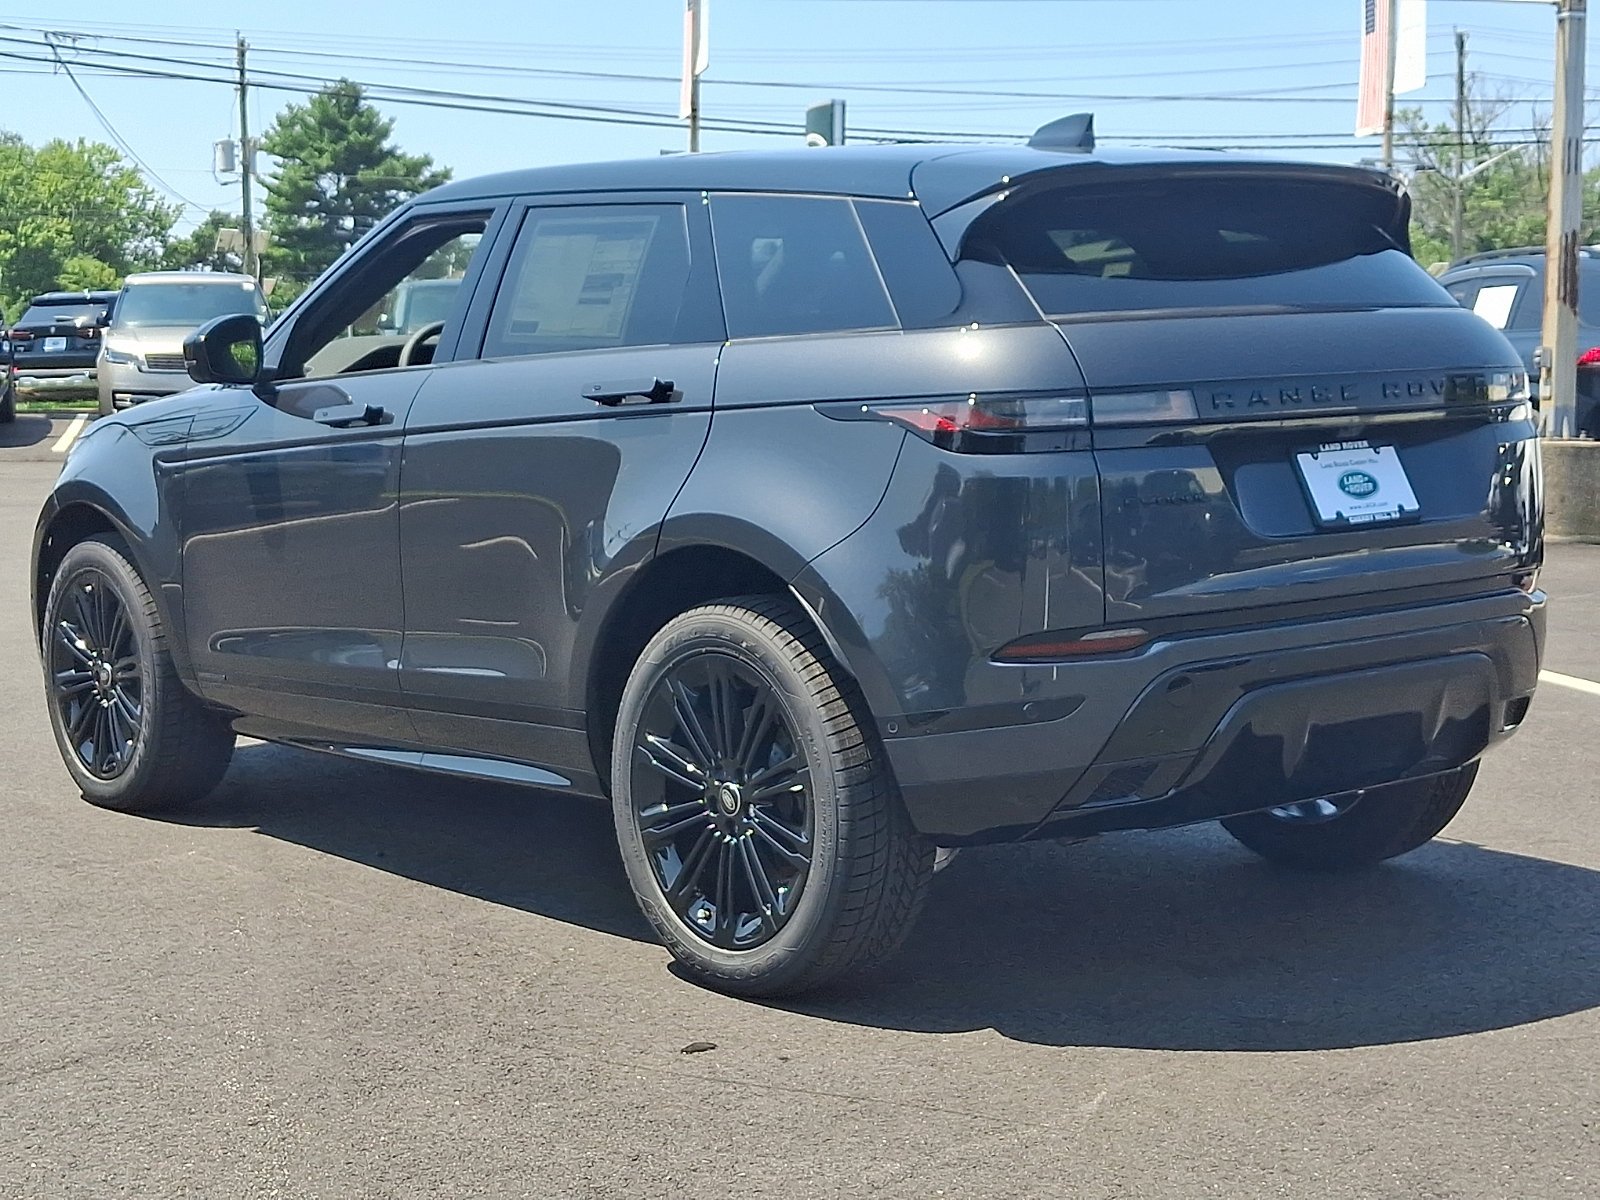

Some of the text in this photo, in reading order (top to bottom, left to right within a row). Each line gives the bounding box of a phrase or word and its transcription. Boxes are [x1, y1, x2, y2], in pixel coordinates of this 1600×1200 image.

[1211, 382, 1359, 410] RANGE
[1319, 440, 1369, 452] LAND ROVER
[1344, 475, 1363, 484] LAND
[1349, 482, 1373, 493] ROVER
